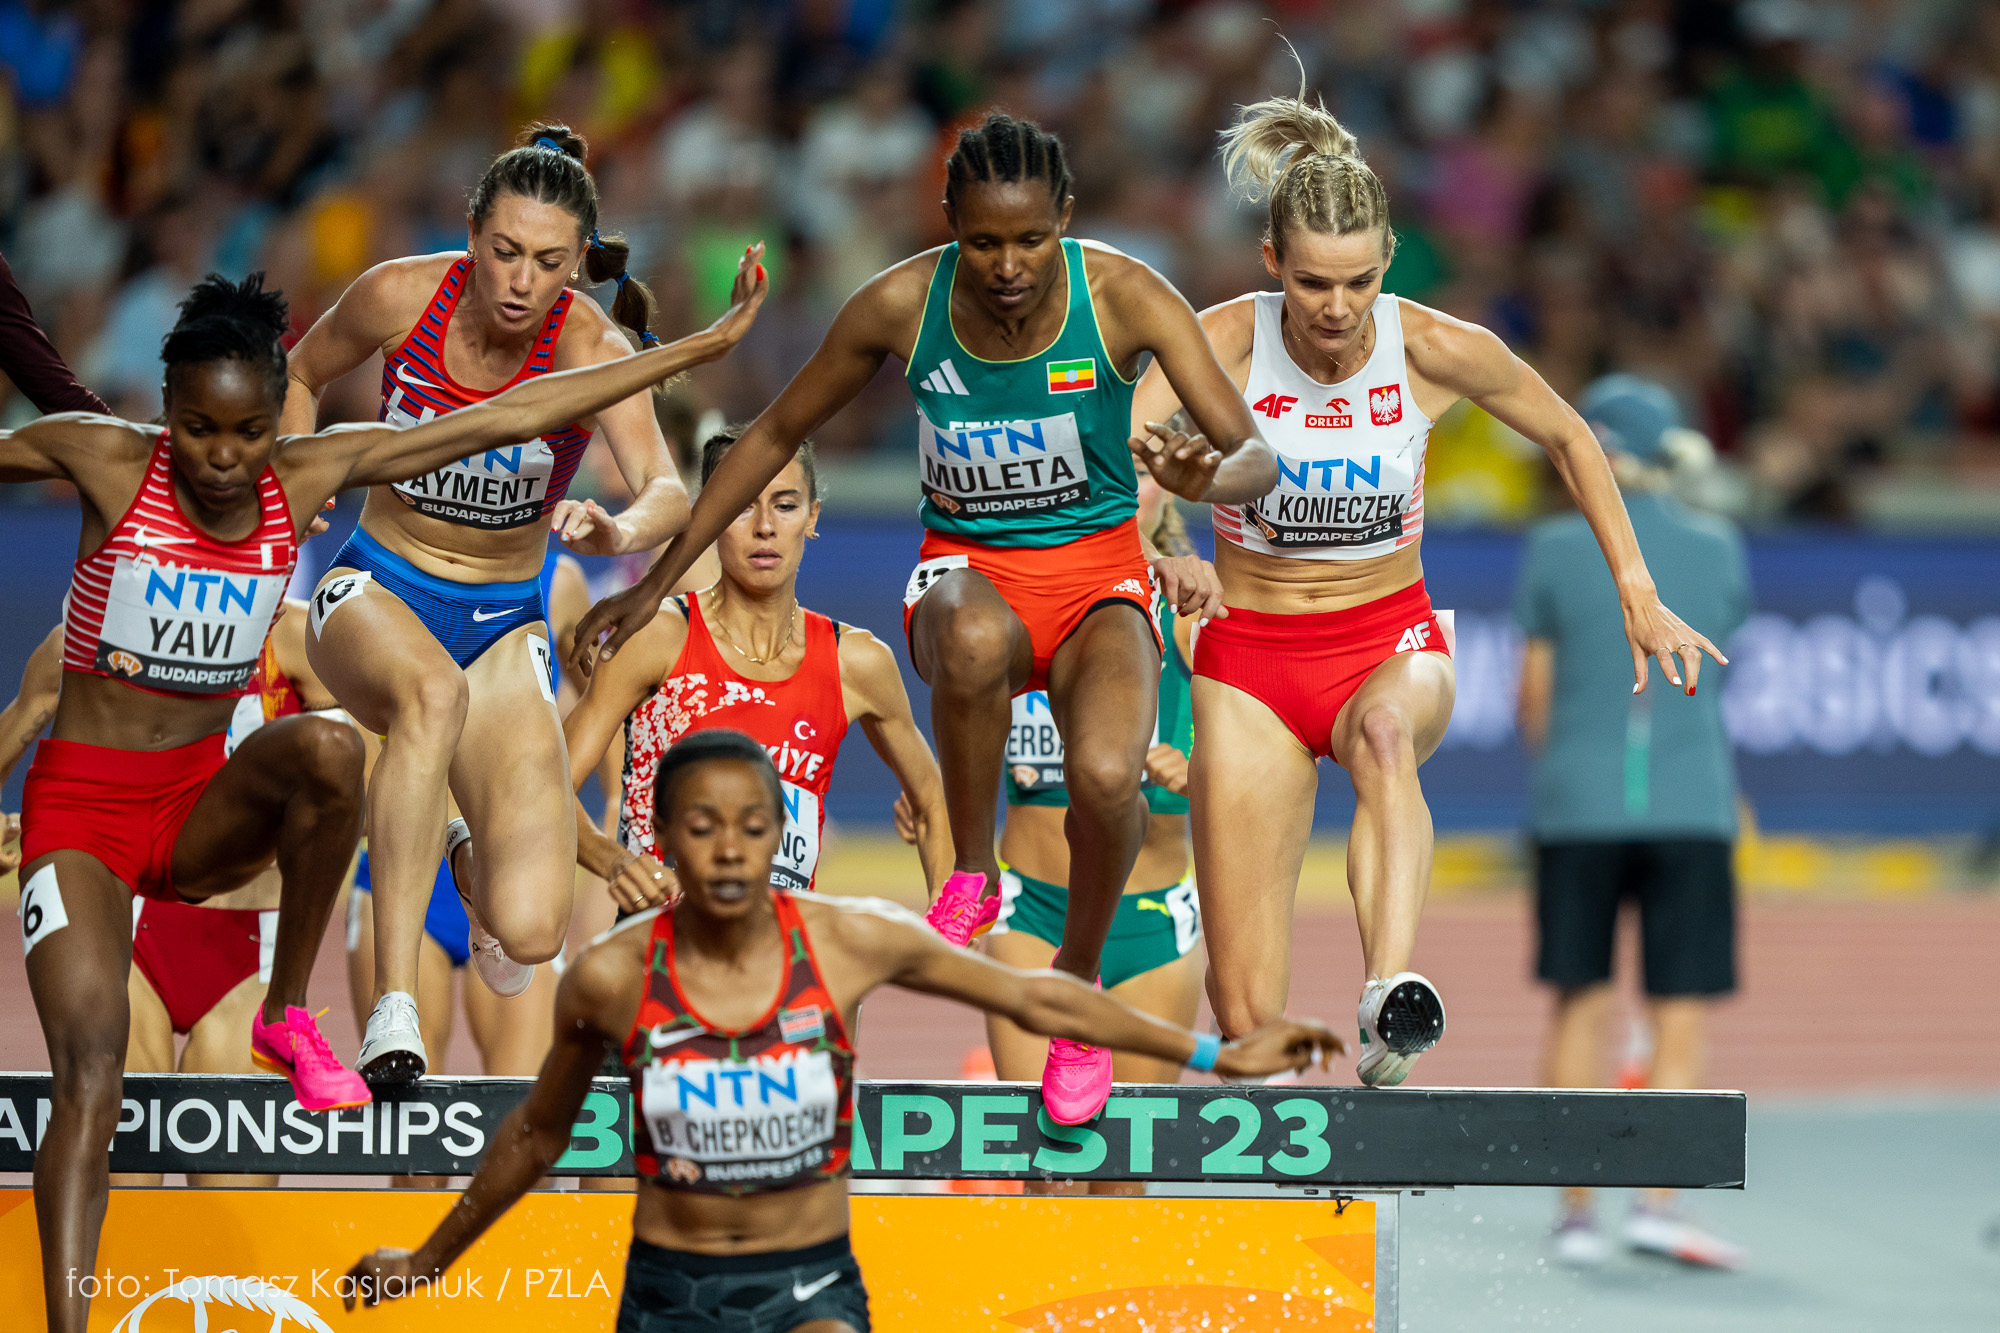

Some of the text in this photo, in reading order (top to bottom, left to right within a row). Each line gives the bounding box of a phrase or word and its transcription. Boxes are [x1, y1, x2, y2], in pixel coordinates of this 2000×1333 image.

[1253, 393, 1299, 420] 4F
[1307, 415, 1350, 428] ORLEN
[933, 421, 1047, 462] NTN
[408, 468, 541, 507] AYMENT
[925, 454, 1076, 494] MULETA
[1276, 453, 1381, 492] NTN
[421, 502, 533, 525] BUDAPEST 23
[965, 488, 1080, 514] BUDAPEST 23
[1277, 493, 1406, 524] KONIECZEK
[1282, 521, 1391, 543] BUDAPEST 23
[144, 567, 259, 618] NTN
[148, 616, 236, 660] YAVI
[1394, 620, 1431, 654] 4F
[147, 663, 234, 685] BUDAPEST
[676, 1066, 798, 1113] NTN
[552, 1092, 1179, 1174] BPEST
[1198, 1097, 1332, 1177] 23
[686, 1104, 828, 1154] CHEPKOECH
